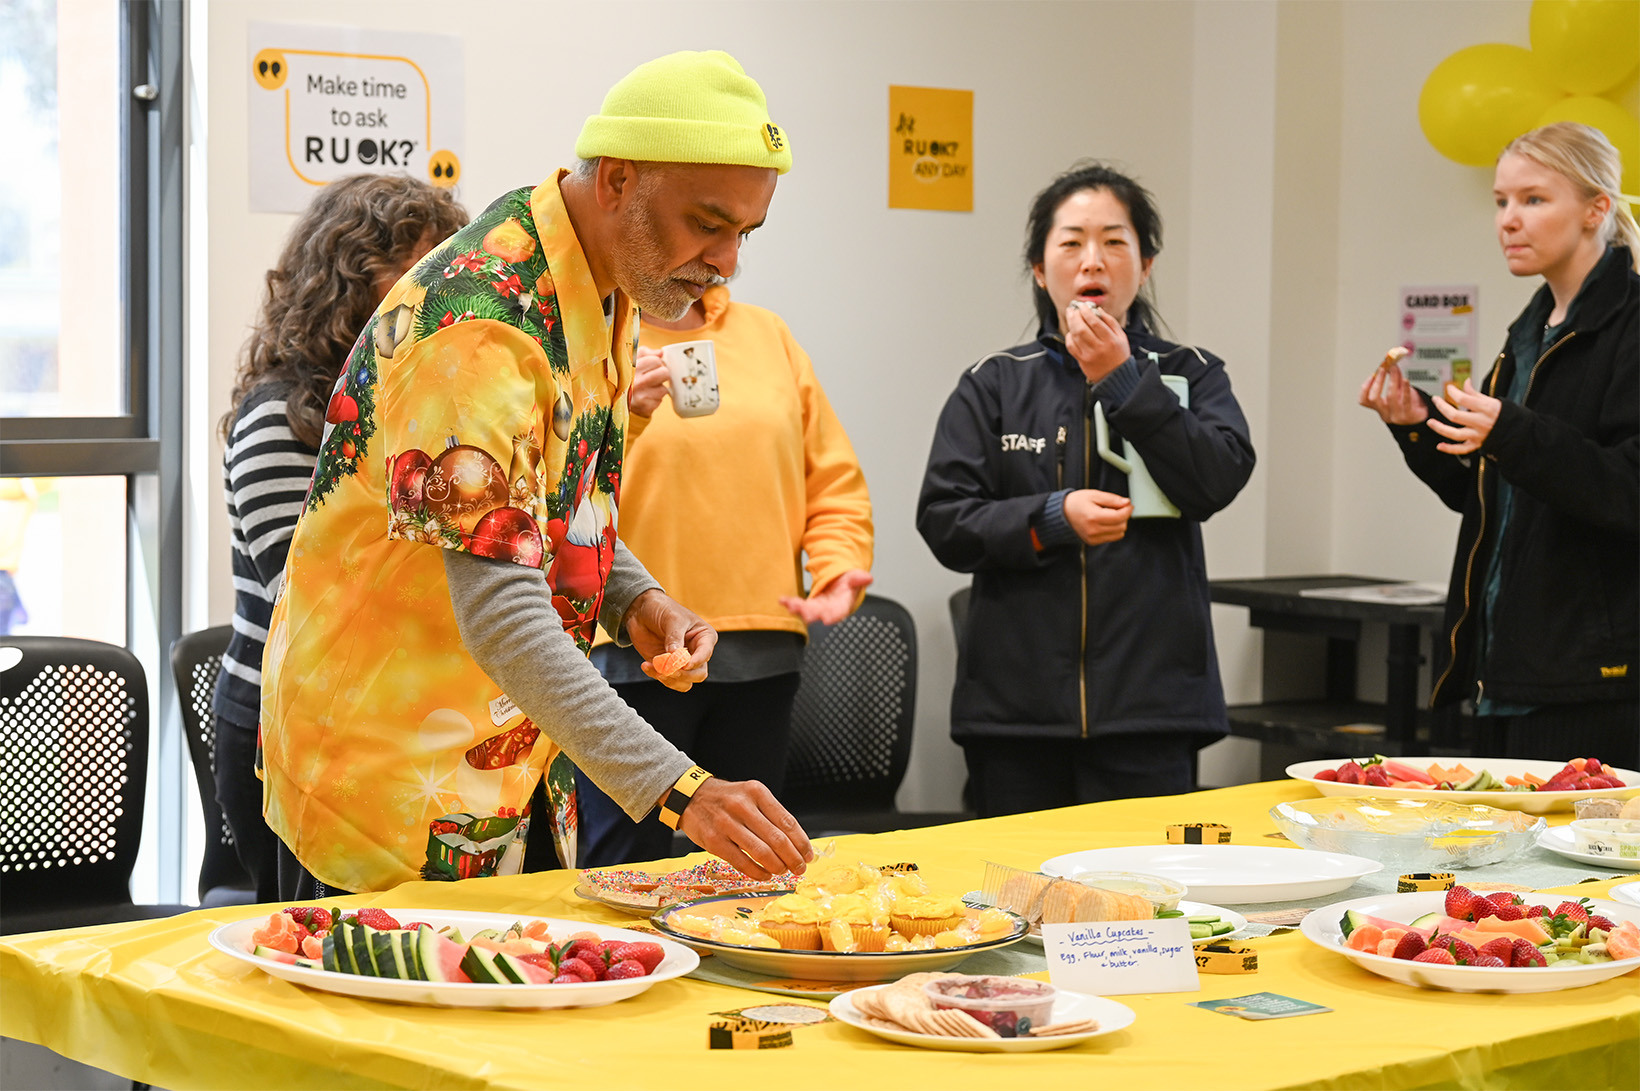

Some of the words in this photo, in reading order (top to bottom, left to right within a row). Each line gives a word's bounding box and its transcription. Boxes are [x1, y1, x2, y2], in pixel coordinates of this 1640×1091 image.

[306, 73, 358, 97] Make
[362, 76, 407, 99] time
[331, 107, 351, 127] to
[355, 107, 388, 128] ask
[915, 161, 940, 176] ANY
[942, 162, 968, 178] DAY
[1405, 294, 1440, 308] CARD
[1443, 294, 1469, 308] BOX
[1000, 433, 1047, 454] STAFF
[1067, 928, 1101, 942] Vanilla
